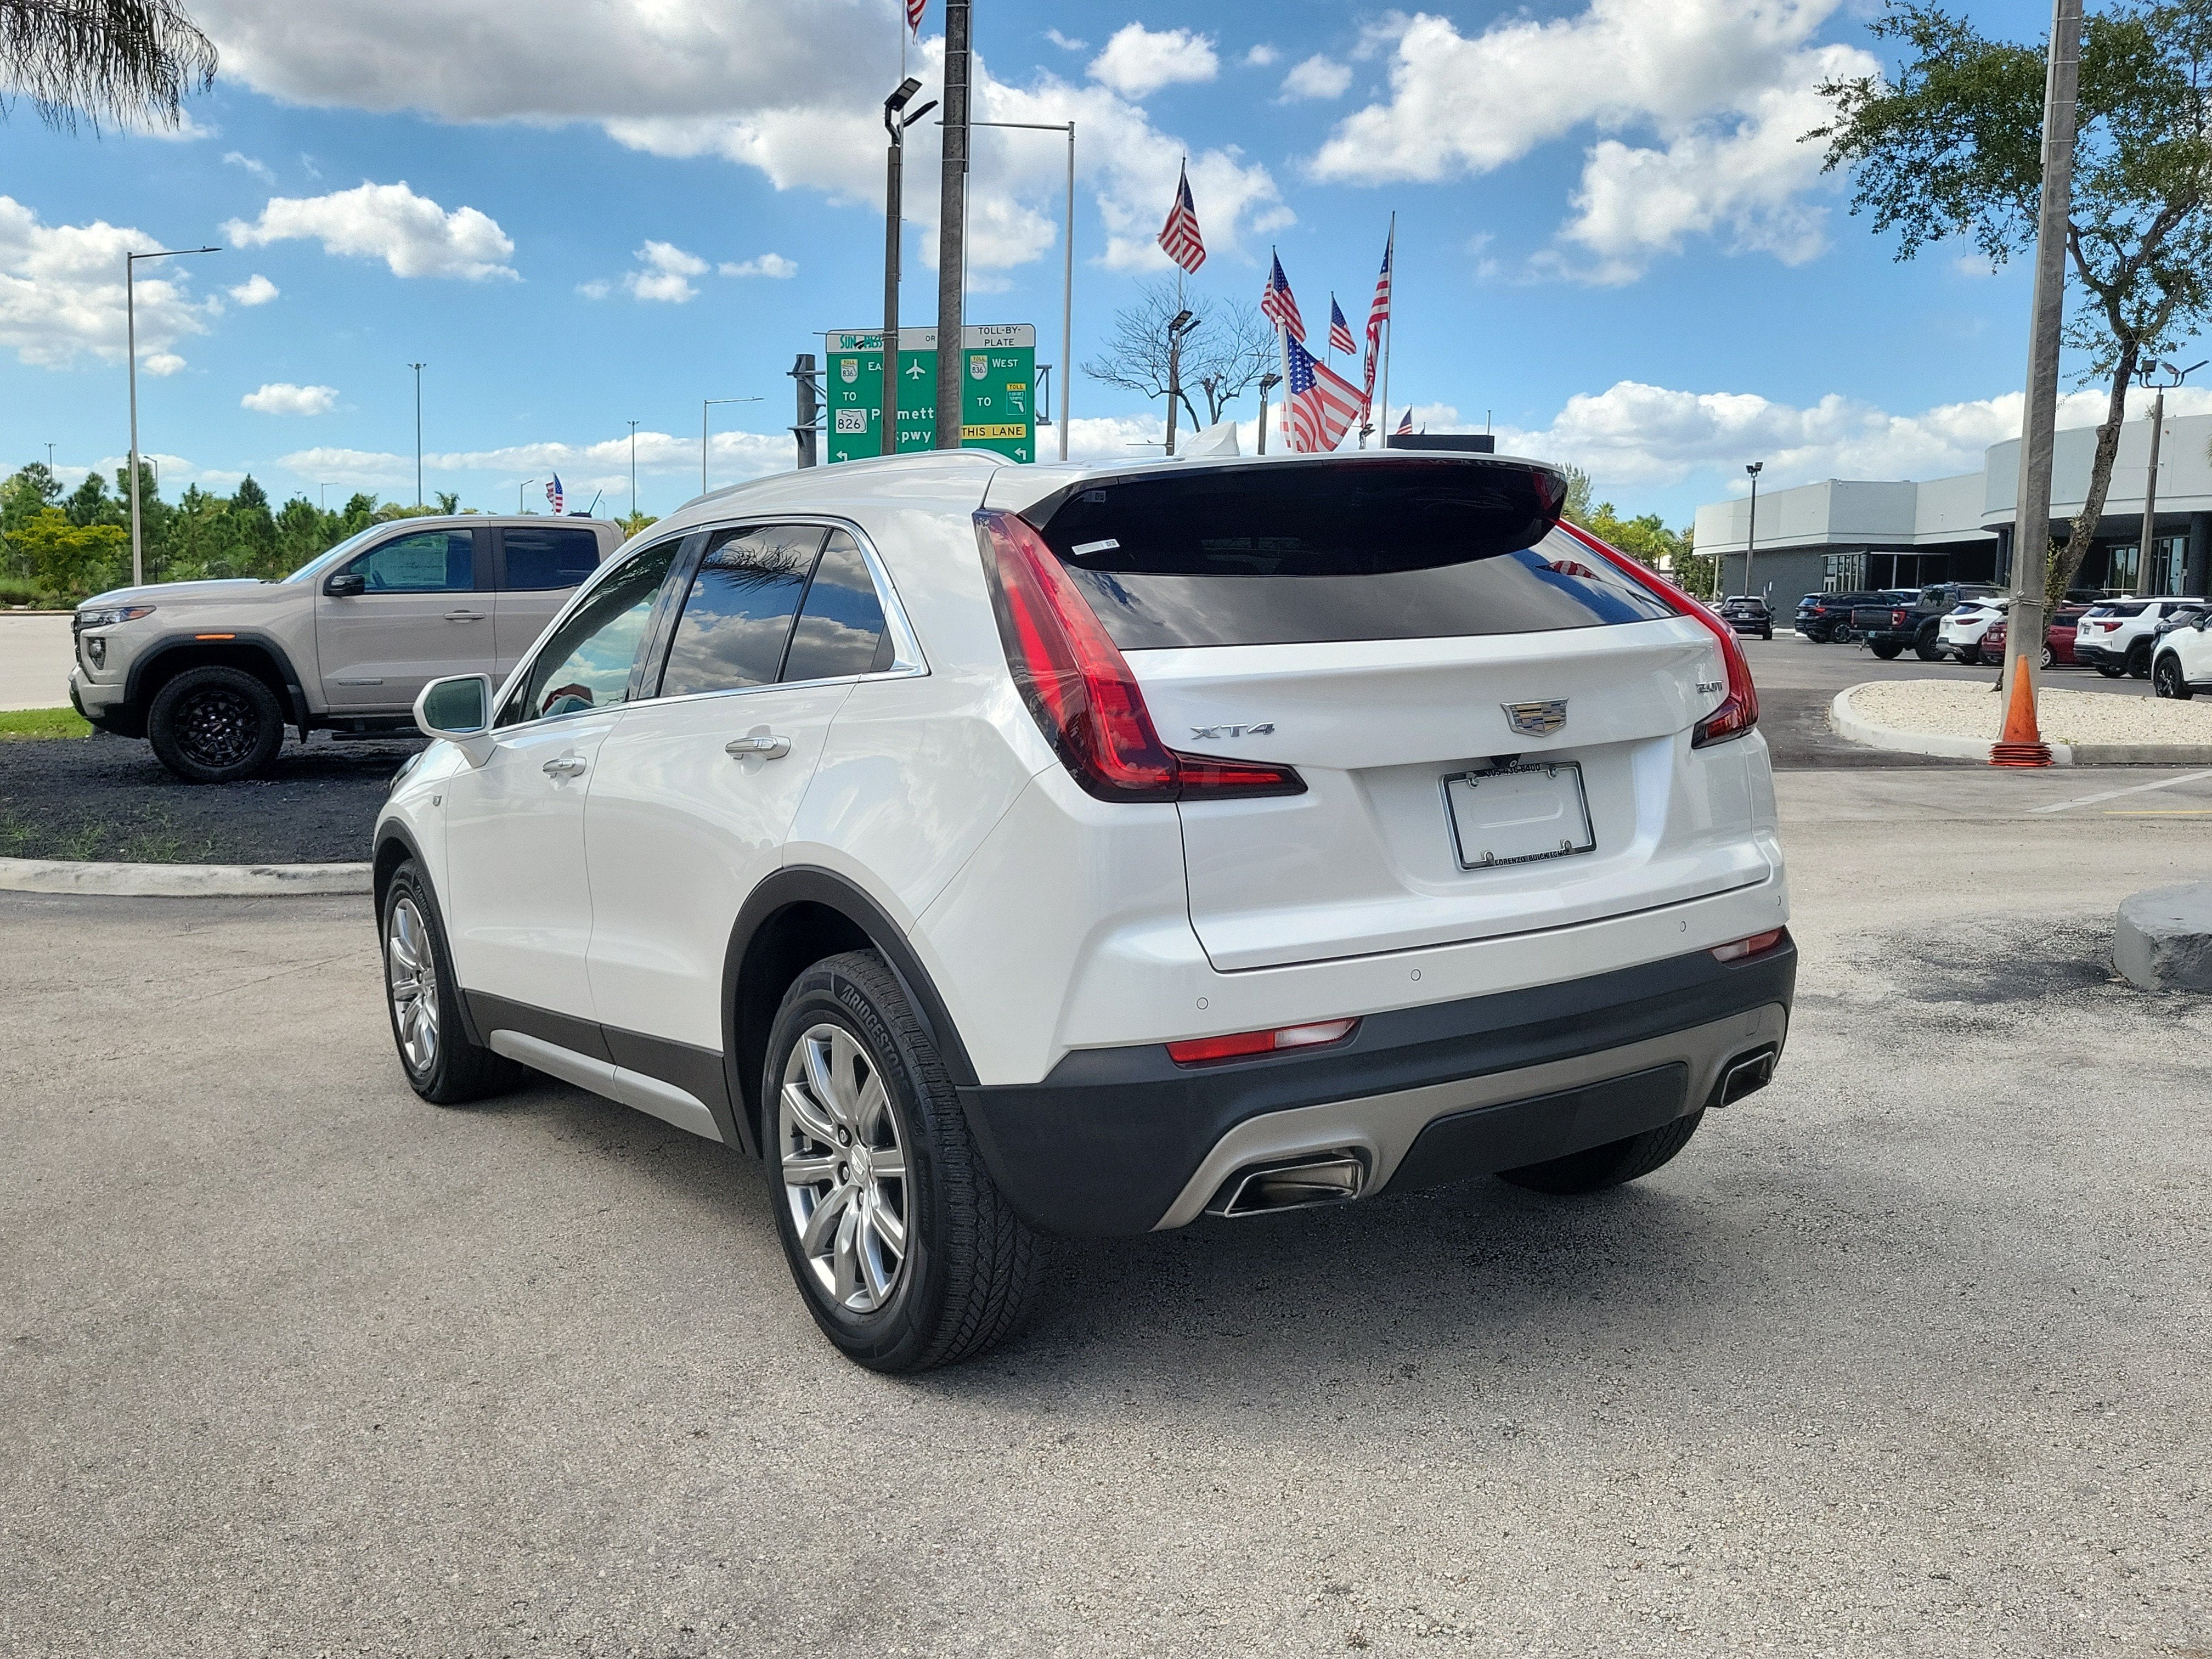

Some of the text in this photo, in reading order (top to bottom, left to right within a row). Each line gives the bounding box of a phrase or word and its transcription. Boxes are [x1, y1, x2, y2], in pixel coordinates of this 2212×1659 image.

[978, 326, 1021, 335] TOLL-BY-
[840, 334, 857, 349] SUN
[868, 362, 884, 371] EA
[992, 358, 1018, 368] WEST
[843, 392, 856, 401] TO
[977, 397, 991, 407] TO
[838, 419, 861, 430] 826
[962, 427, 1023, 437] THIS LANE
[1190, 721, 1275, 740] XT4
[1494, 856, 1526, 866] LORENZO
